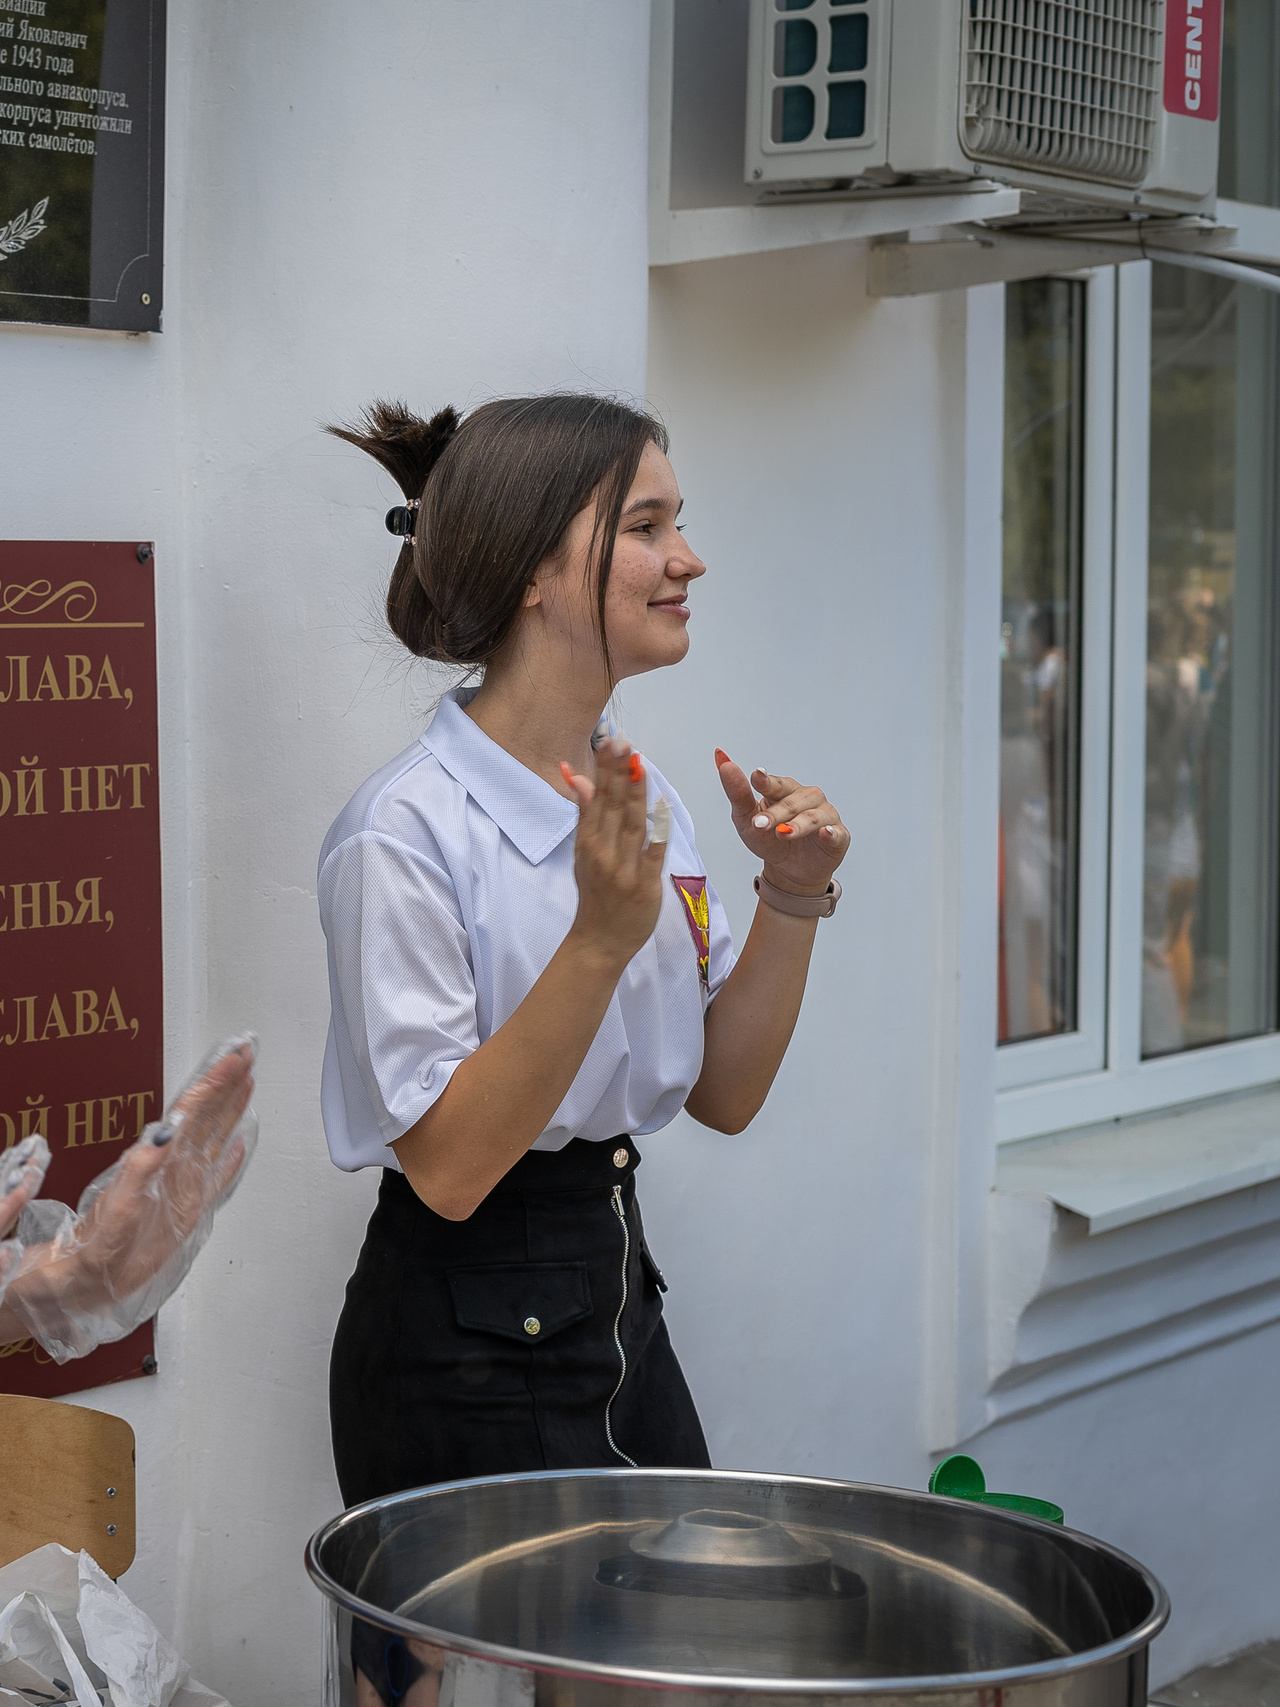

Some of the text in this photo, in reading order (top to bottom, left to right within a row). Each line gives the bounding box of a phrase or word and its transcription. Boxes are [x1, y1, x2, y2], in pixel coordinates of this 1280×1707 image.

[17, 19, 89, 49] Яковлевич
[12, 44, 42, 69] 1943
[45, 55, 74, 76] года
[47, 82, 129, 110] авиакорпуса.
[55, 109, 133, 134] уничтожили
[28, 132, 98, 156] самолётов.
[59, 763, 150, 814] НЕТ
[64, 1091, 154, 1149] НЕТ
